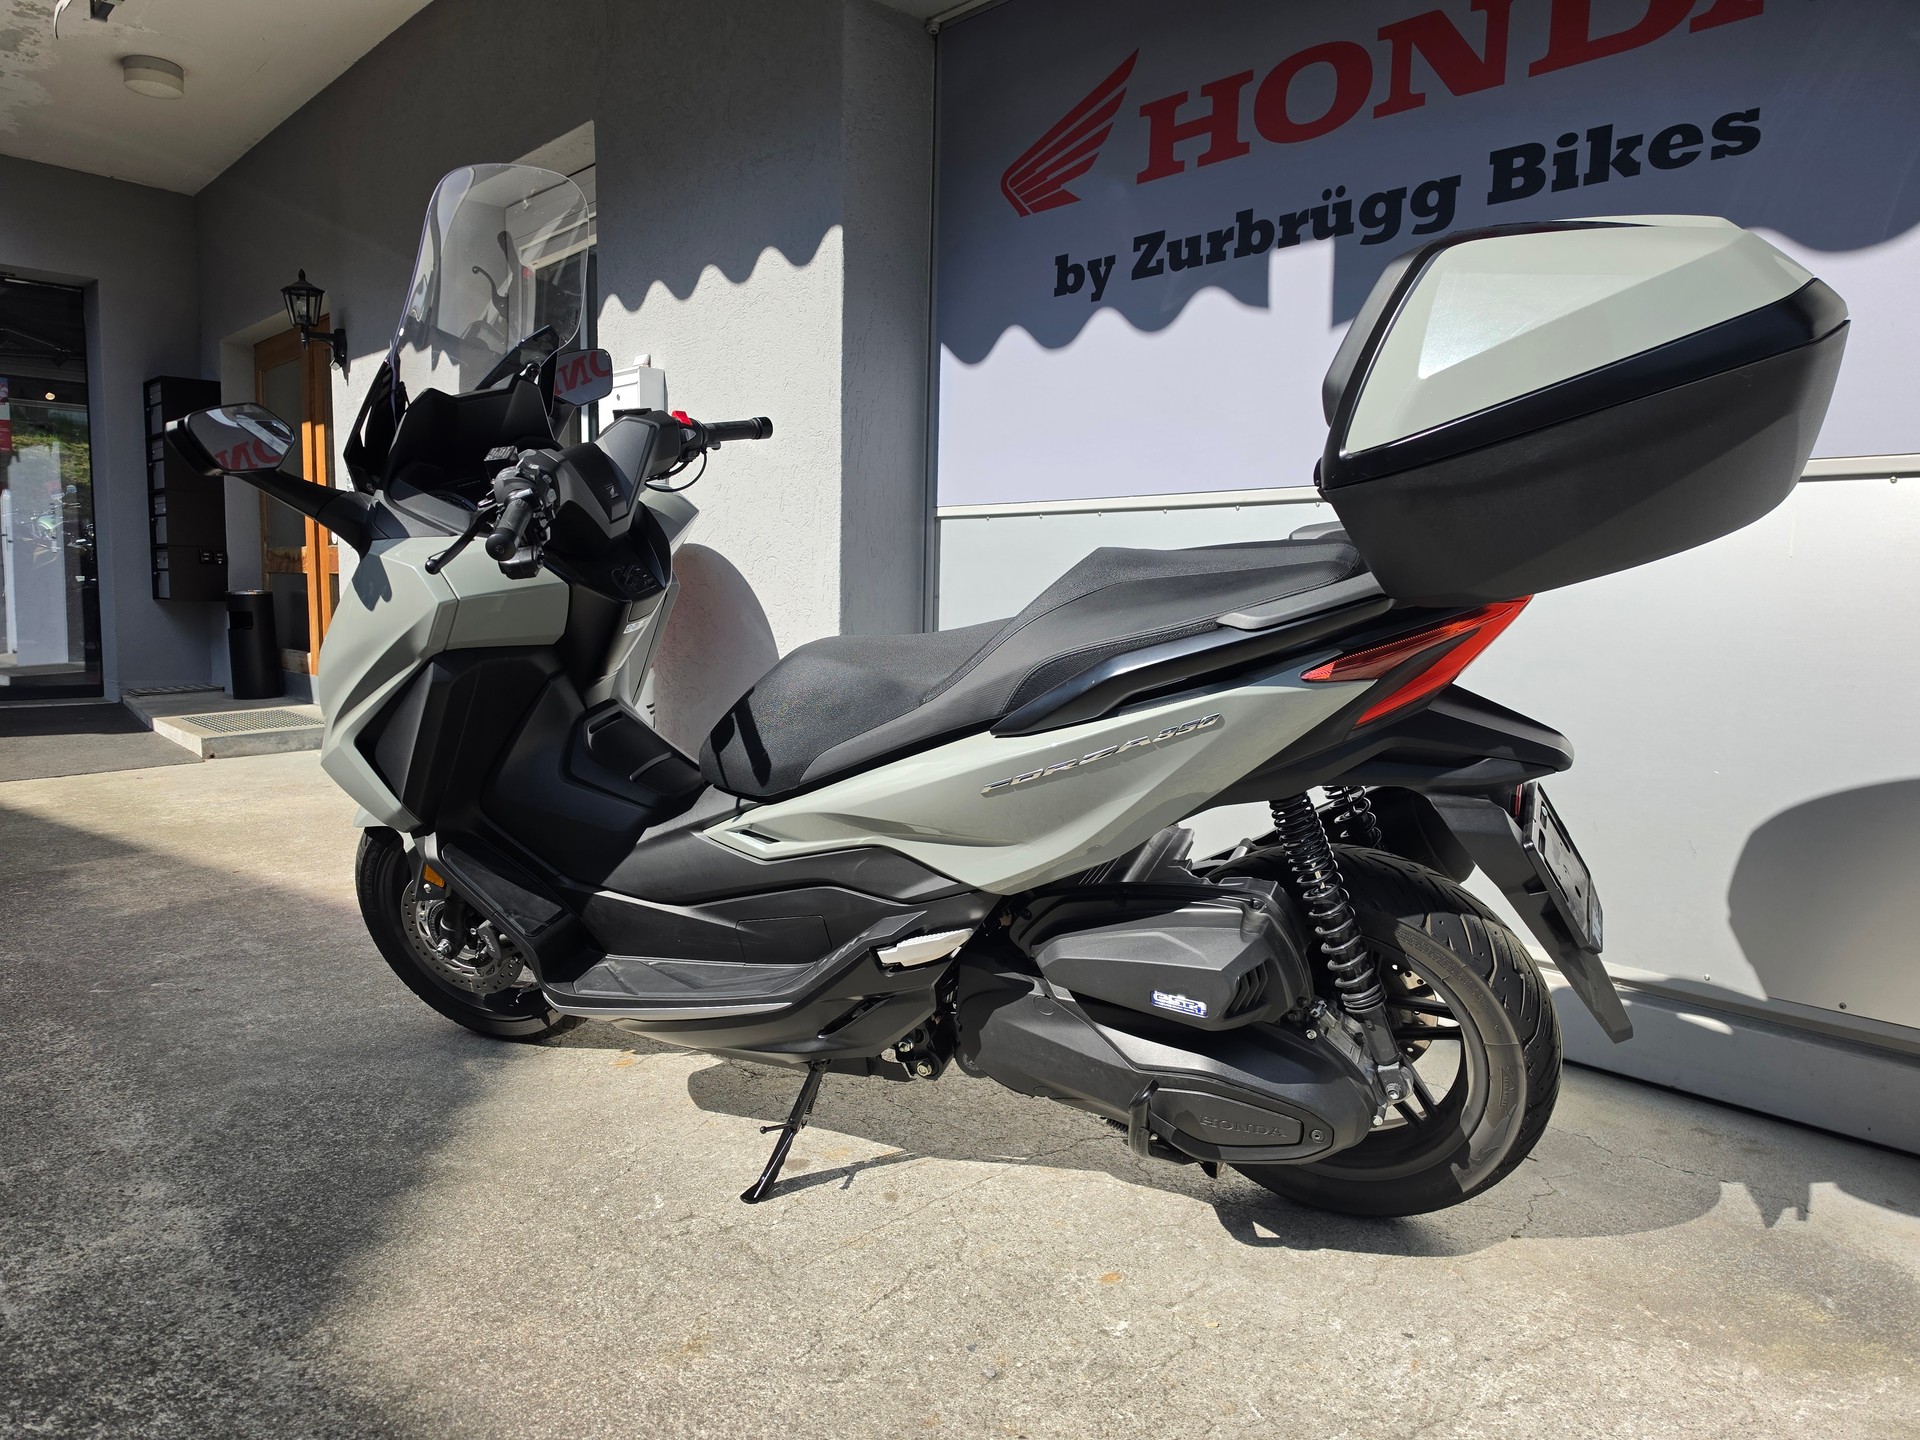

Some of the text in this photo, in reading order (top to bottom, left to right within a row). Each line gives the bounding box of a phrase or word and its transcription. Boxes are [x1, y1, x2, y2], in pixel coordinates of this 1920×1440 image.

[1136, 0, 1764, 184] HOND
[1053, 107, 1761, 303] by Zurbrügg Bikes
[1152, 712, 1221, 743] 350
[1199, 1114, 1287, 1138] HONDA
